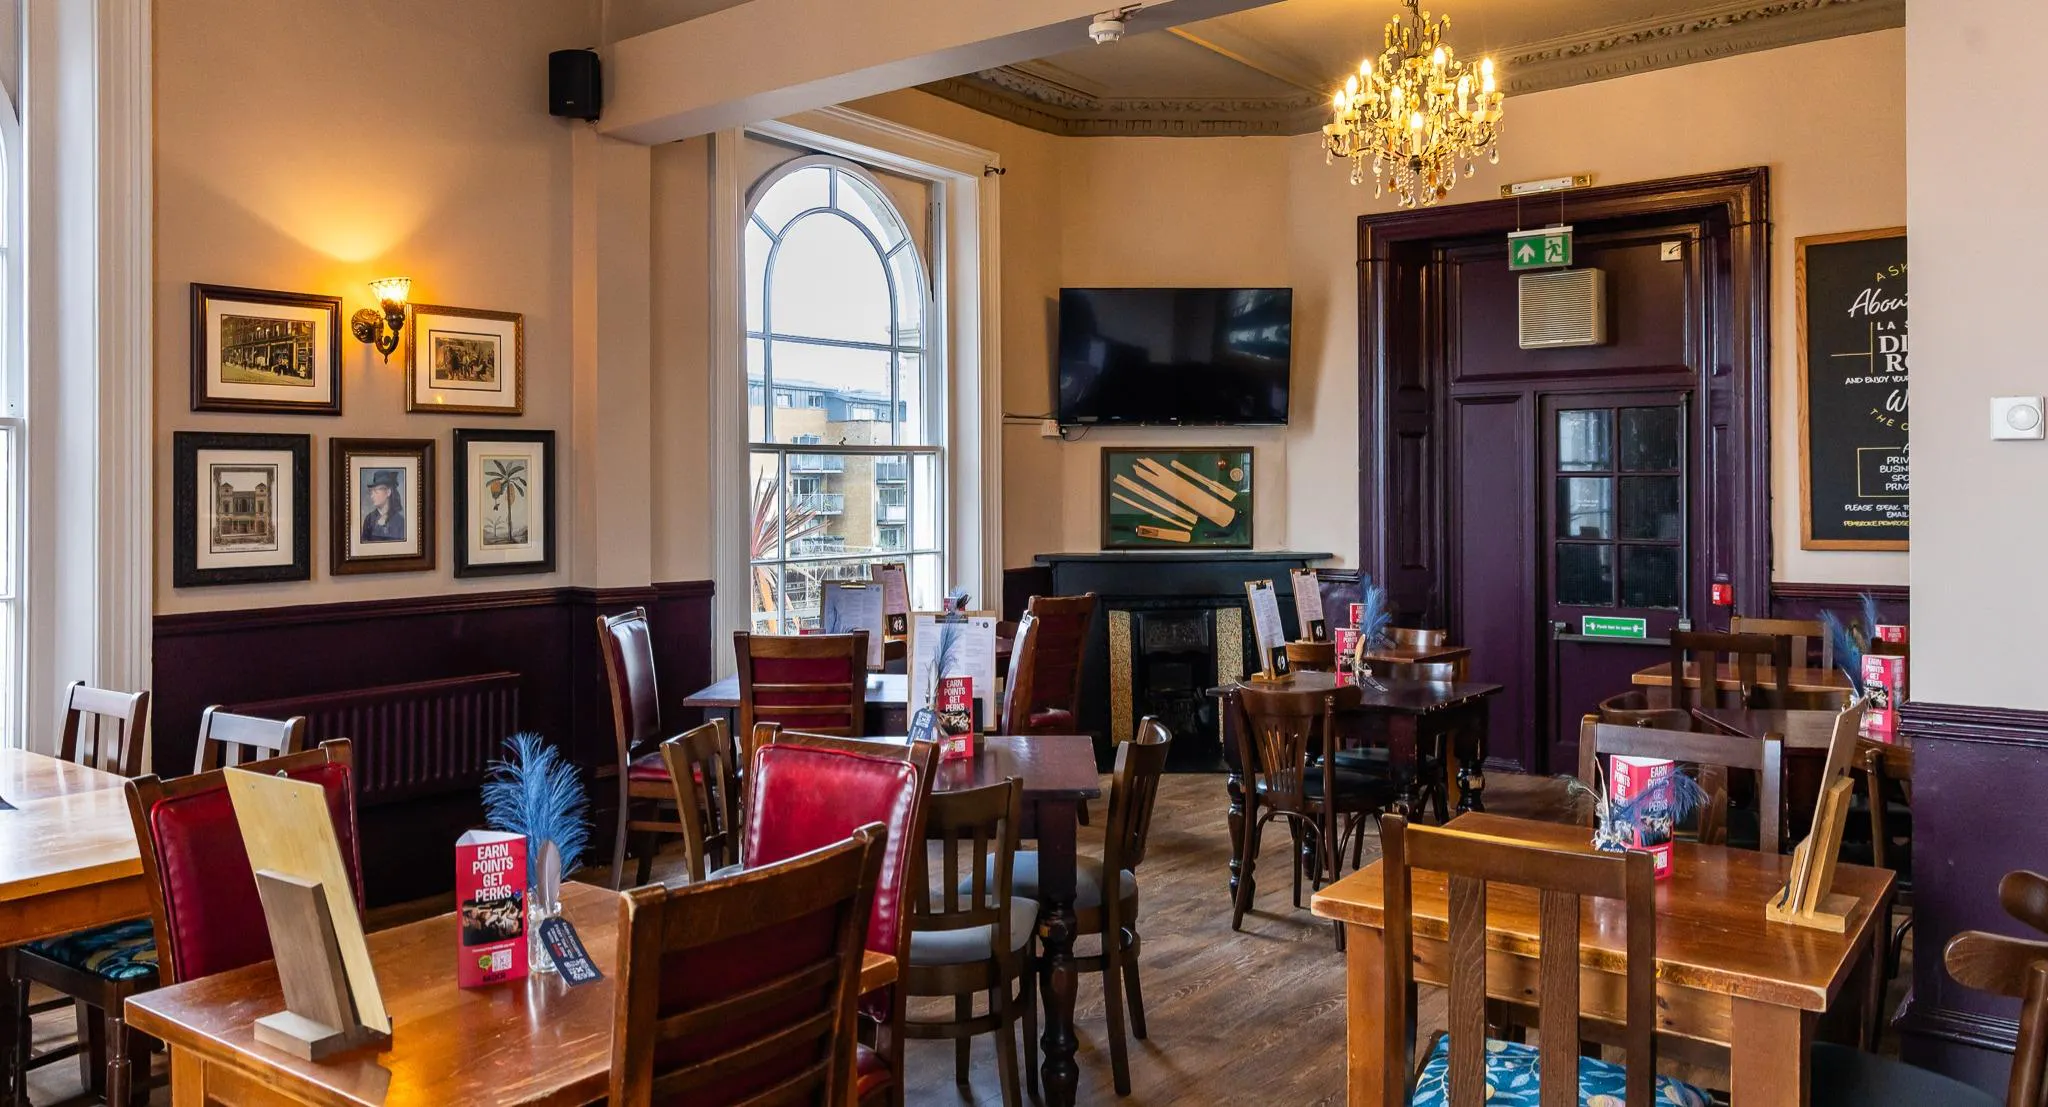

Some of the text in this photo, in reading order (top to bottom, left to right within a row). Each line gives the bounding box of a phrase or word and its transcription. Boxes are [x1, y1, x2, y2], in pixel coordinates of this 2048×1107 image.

[1877, 321, 1896, 332] LA
[1845, 377, 1864, 385] AND
[1865, 375, 1889, 384] ENJOY
[1870, 408, 1895, 427] THE
[1844, 504, 1873, 512] PLEASE
[946, 679, 963, 688] EARN
[944, 687, 966, 696] POINTS
[949, 695, 960, 704] GET
[945, 703, 965, 712] PERKS
[1616, 760, 1628, 774] EARN
[1650, 765, 1668, 778] EARN
[1614, 771, 1631, 788] POINTS
[1617, 784, 1626, 796] GET
[477, 843, 509, 861] EARN
[472, 856, 514, 875] POINTS
[482, 871, 504, 888] GET
[475, 884, 512, 904] PERKS
